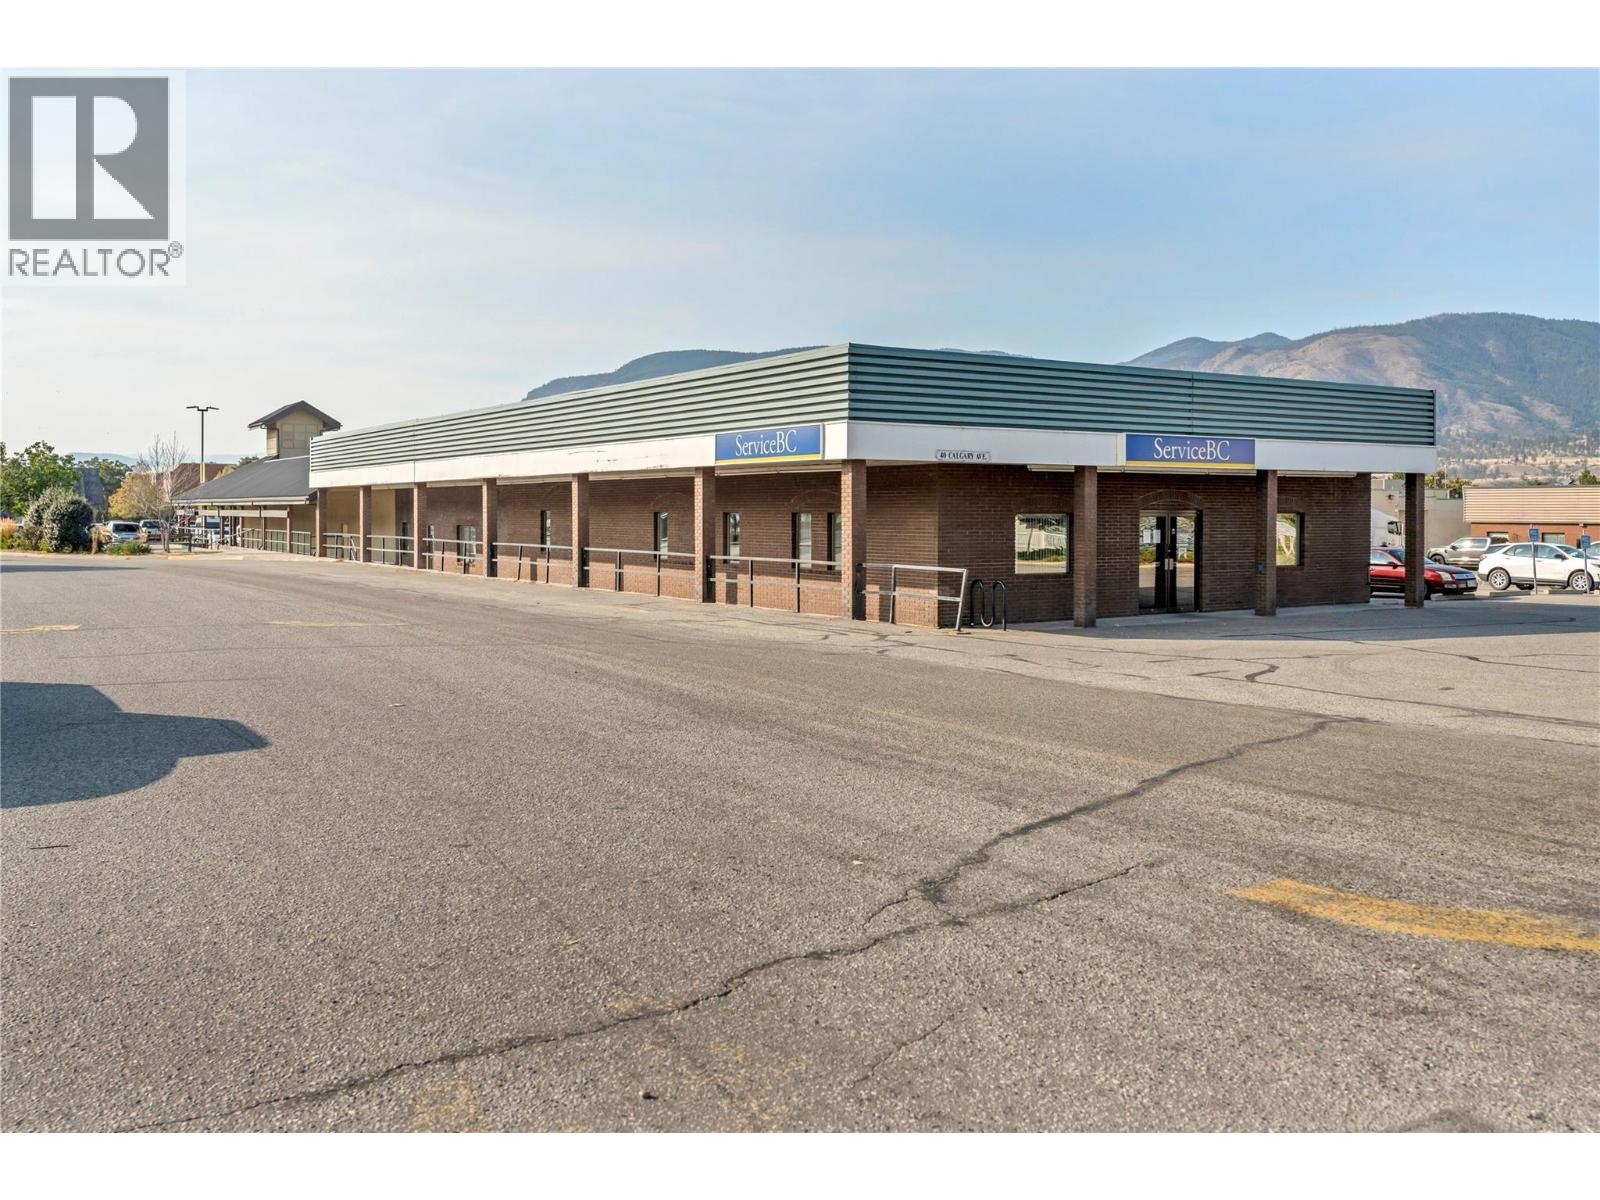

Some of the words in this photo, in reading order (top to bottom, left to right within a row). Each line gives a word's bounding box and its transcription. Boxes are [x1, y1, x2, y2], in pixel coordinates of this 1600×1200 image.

[735, 429, 797, 457] ServiceBC
[1153, 437, 1230, 461] ServiceBC
[948, 452, 974, 460] CALGARY
